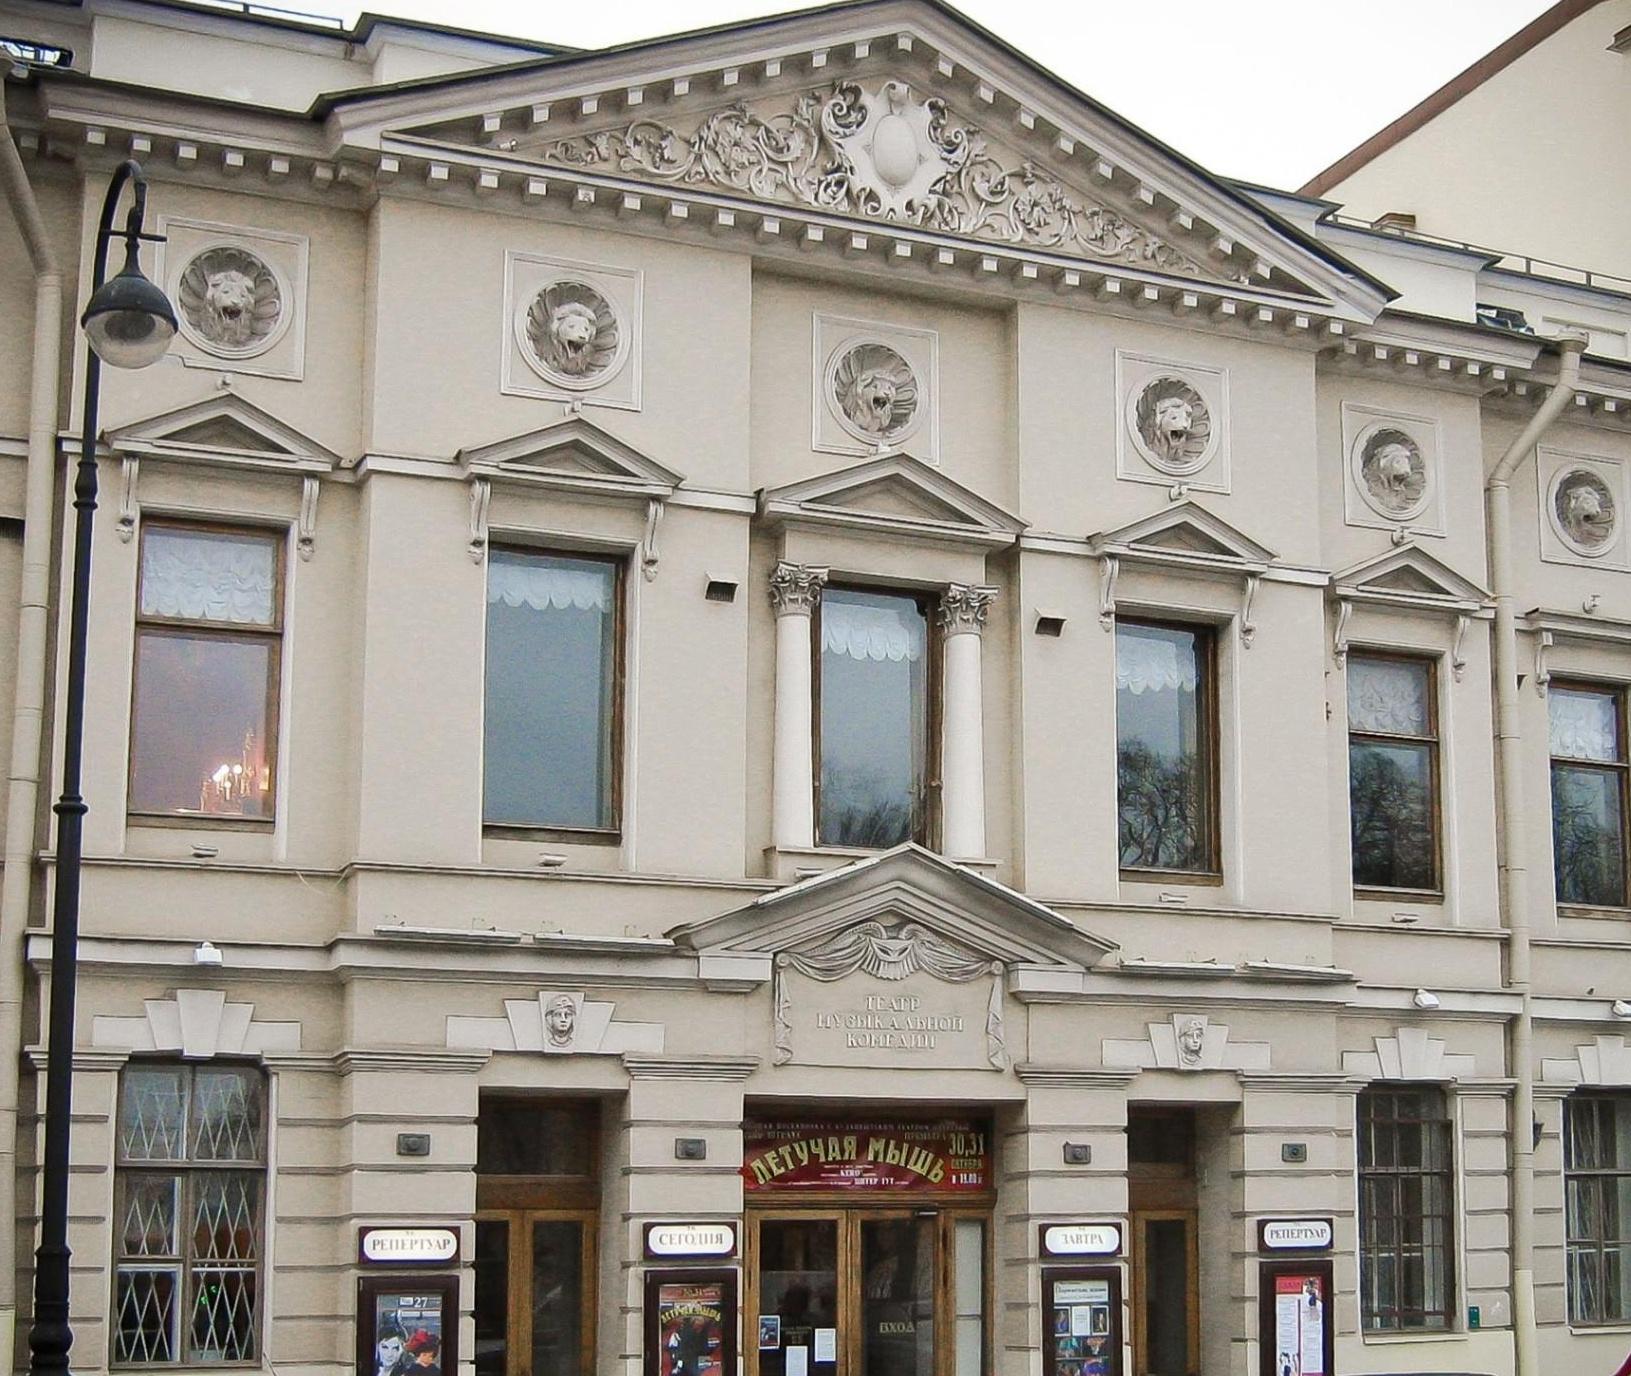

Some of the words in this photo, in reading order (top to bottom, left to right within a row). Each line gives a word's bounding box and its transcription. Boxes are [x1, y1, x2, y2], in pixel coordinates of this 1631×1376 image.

[866, 996, 921, 1012] ТЕАТР
[816, 1013, 964, 1032] МУЗЫКАЛЬНОЙ
[846, 1033, 937, 1049] КОМЕДИИ
[750, 1136, 858, 1185] ЛЕТУЧАЯ
[867, 1136, 946, 1184] МЫШЬ
[659, 1233, 724, 1246] СЕГОДНЯ
[1061, 1233, 1104, 1245] ЗАВТРА
[1270, 1228, 1327, 1240] РЕПЕРТУАР
[372, 1238, 451, 1251] РЕПЕРТУАР
[414, 1296, 428, 1308] 27
[879, 1322, 915, 1333] ВХОД
